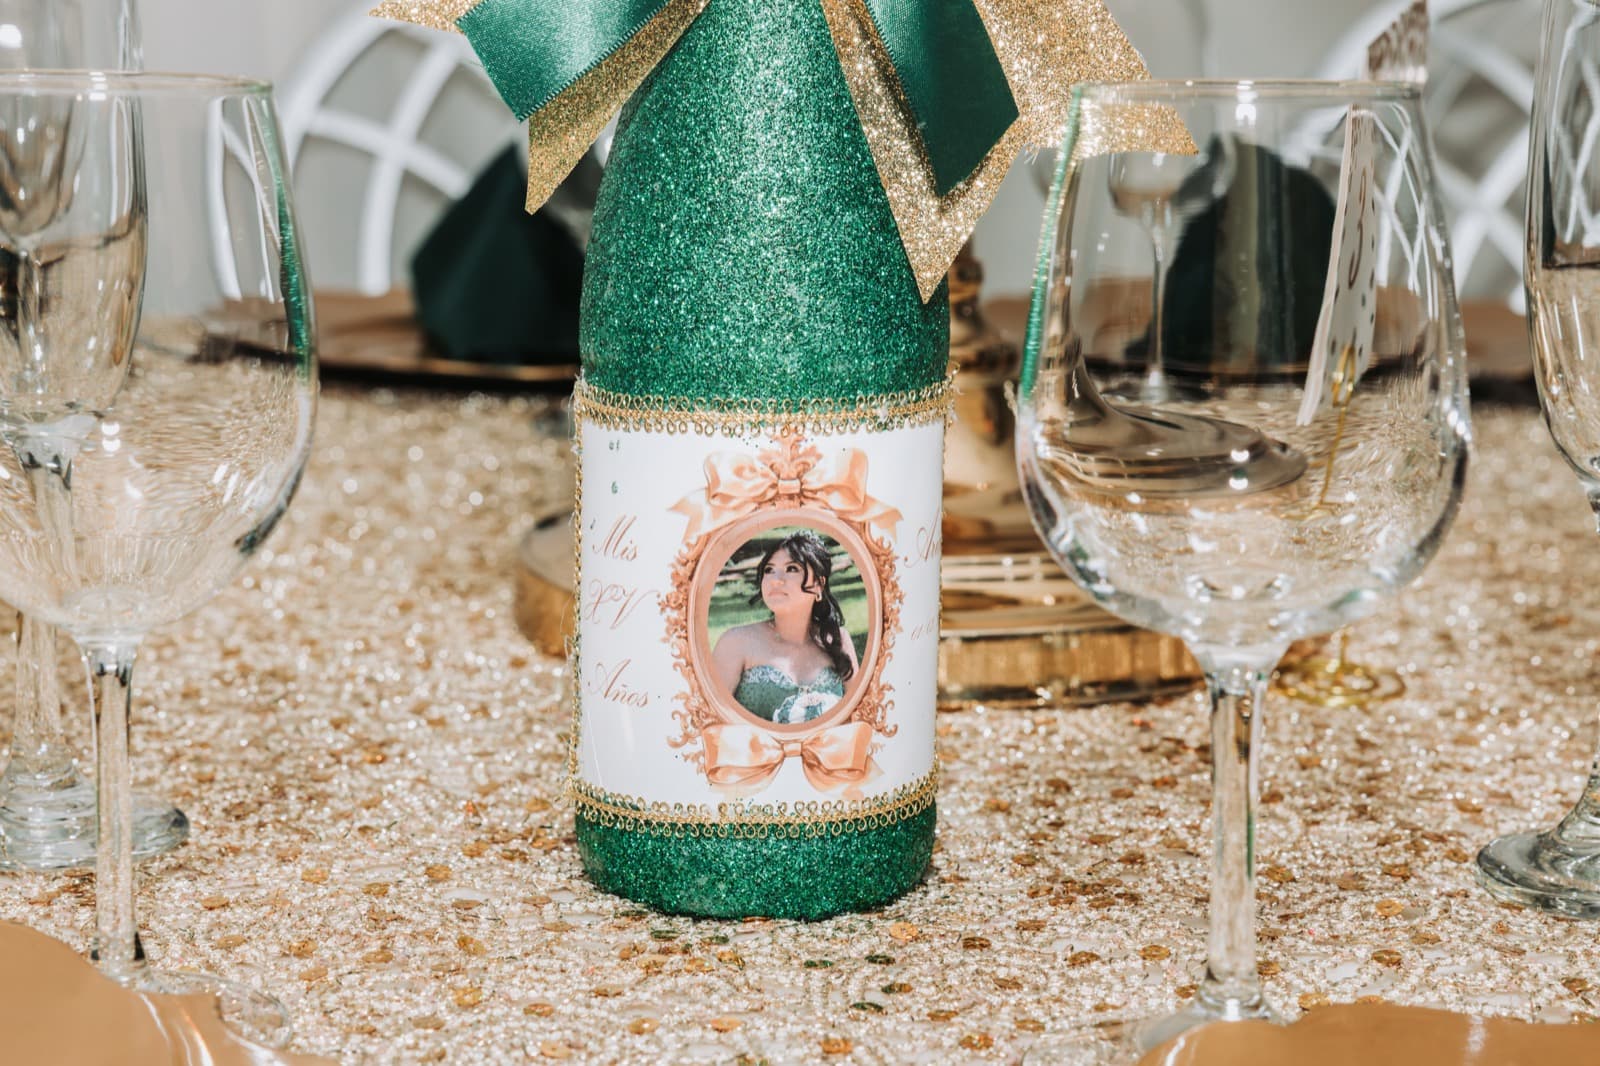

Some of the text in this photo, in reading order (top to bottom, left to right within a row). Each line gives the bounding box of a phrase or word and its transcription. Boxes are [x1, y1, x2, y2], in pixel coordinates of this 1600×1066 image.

[592, 515, 638, 561] Mis
[585, 578, 658, 630] XV
[588, 658, 650, 707] Años
